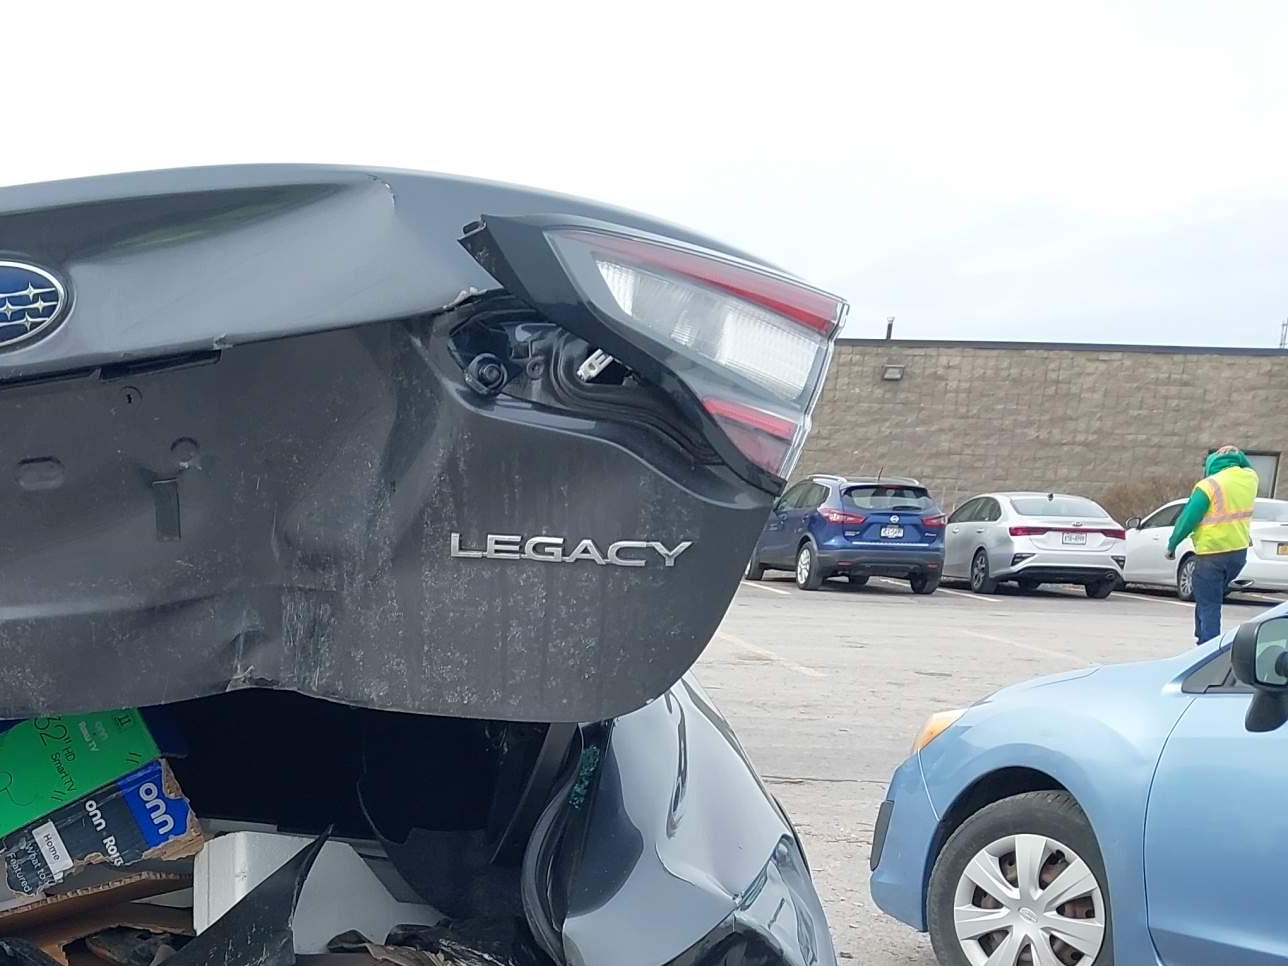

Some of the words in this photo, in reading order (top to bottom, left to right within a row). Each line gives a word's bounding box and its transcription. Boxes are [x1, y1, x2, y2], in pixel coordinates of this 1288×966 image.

[450, 532, 693, 567] LEGACY
[63, 746, 76, 762] HD
[85, 800, 107, 832] onn
[139, 782, 175, 835] onn
[25, 842, 42, 869] What
[36, 867, 48, 880] to
[43, 833, 61, 861] Home
[7, 852, 32, 893] Featured
